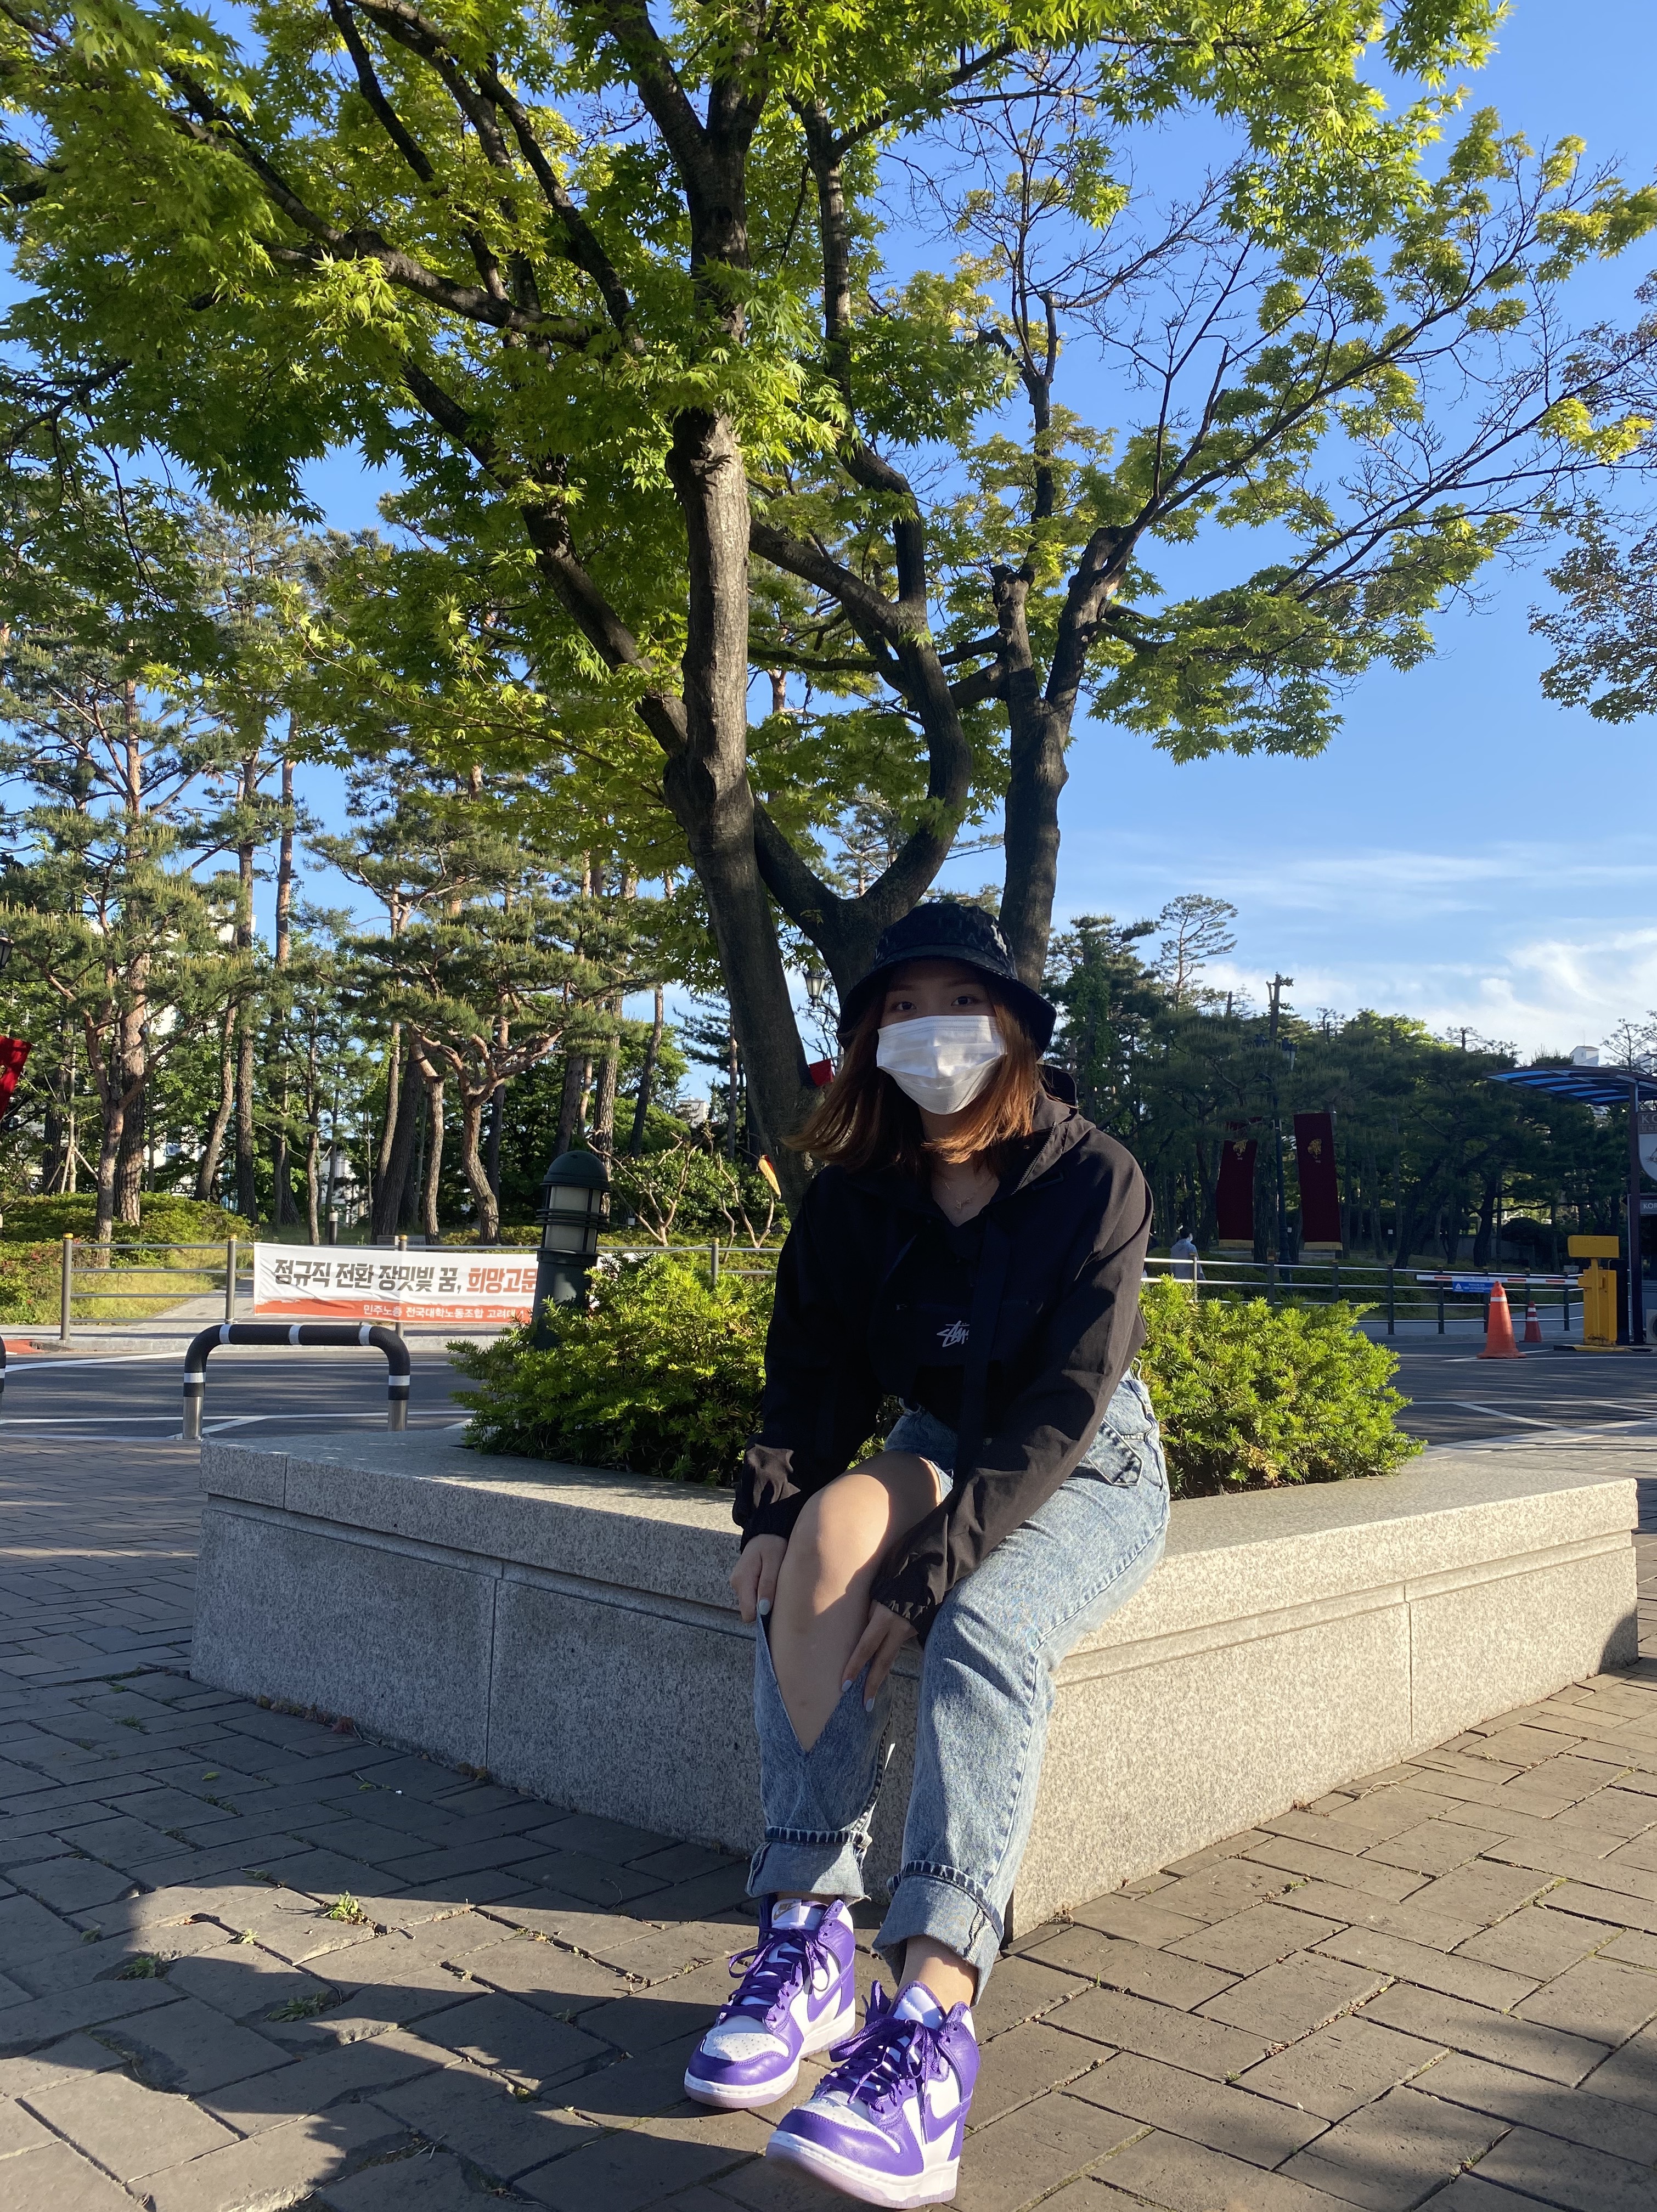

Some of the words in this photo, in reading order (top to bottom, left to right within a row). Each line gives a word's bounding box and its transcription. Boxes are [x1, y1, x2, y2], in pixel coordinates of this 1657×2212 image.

[274, 1259, 331, 1288] 정규직
[335, 1263, 374, 1289] 전환
[378, 1265, 435, 1292] 장밋빛
[438, 1267, 461, 1294] 꿈,
[466, 1268, 538, 1294] 희망고문
[364, 1304, 402, 1317] 민주노총
[405, 1307, 484, 1319] 전국대학노동조합
